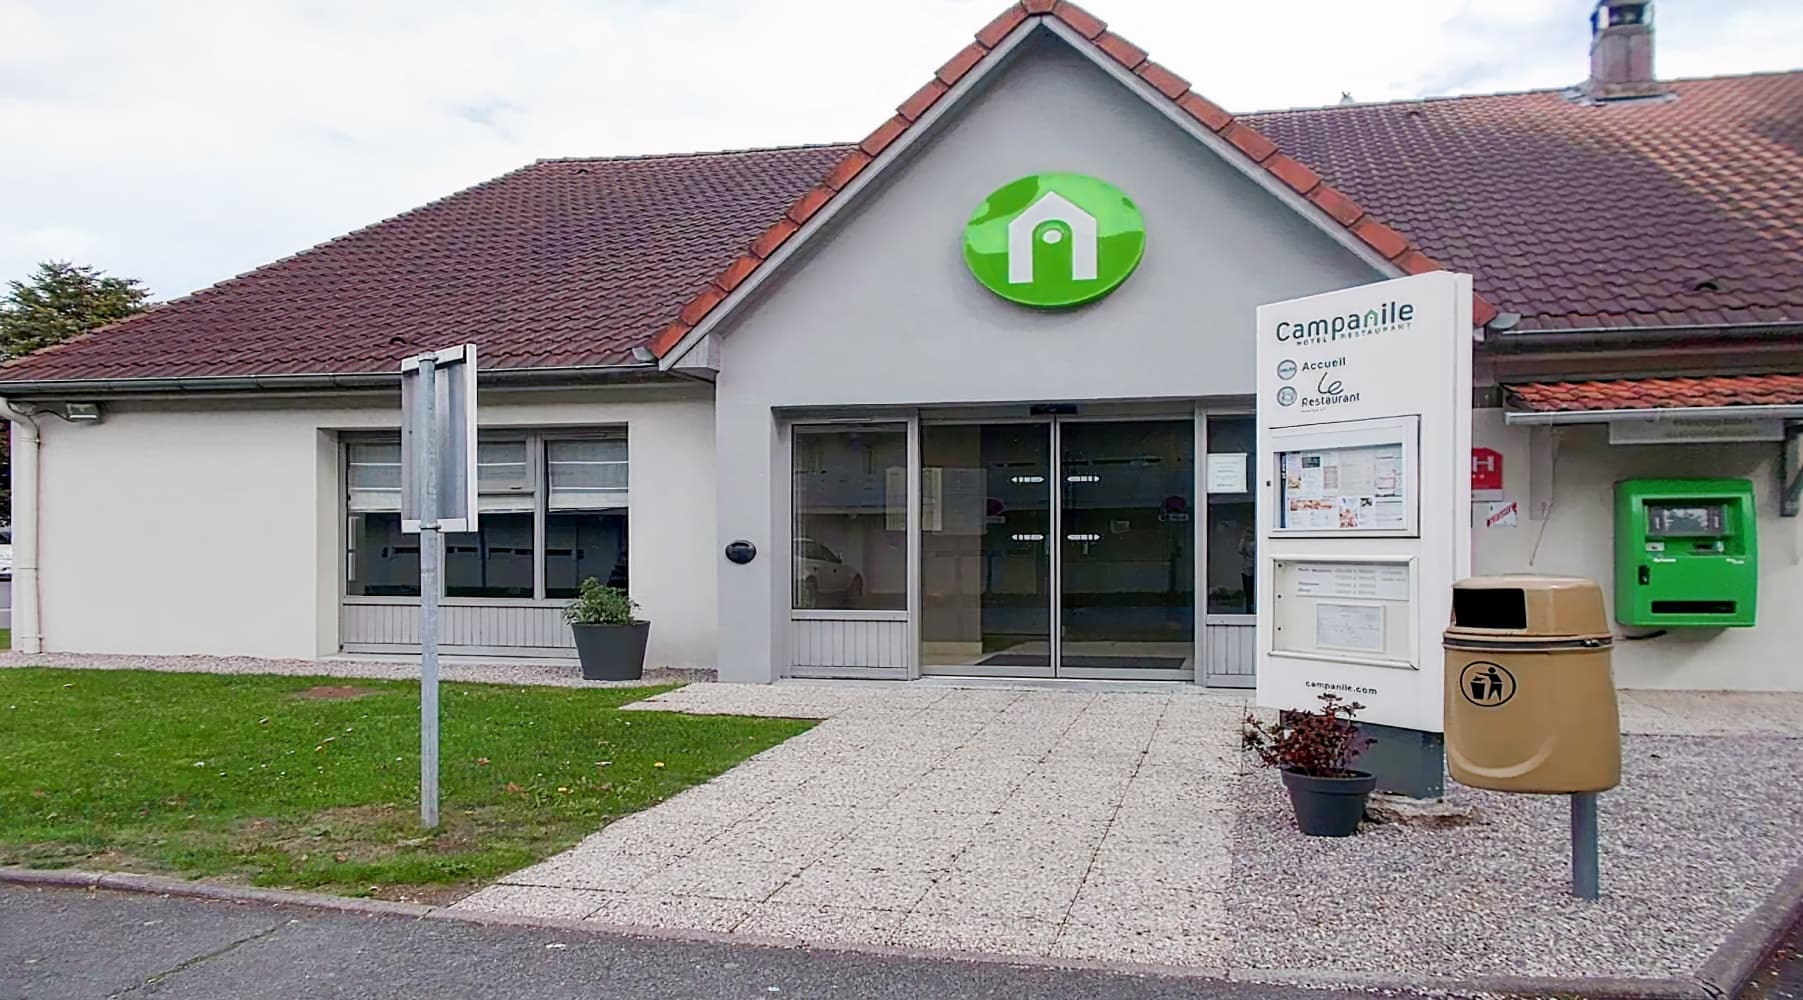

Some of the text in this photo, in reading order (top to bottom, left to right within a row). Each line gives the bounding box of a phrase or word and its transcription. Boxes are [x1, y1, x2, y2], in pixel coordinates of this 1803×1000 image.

[1276, 301, 1414, 341] Campanile
[1302, 356, 1346, 372] Accueil
[1301, 392, 1360, 407] Restaurant
[1305, 681, 1378, 696] campanile.com
